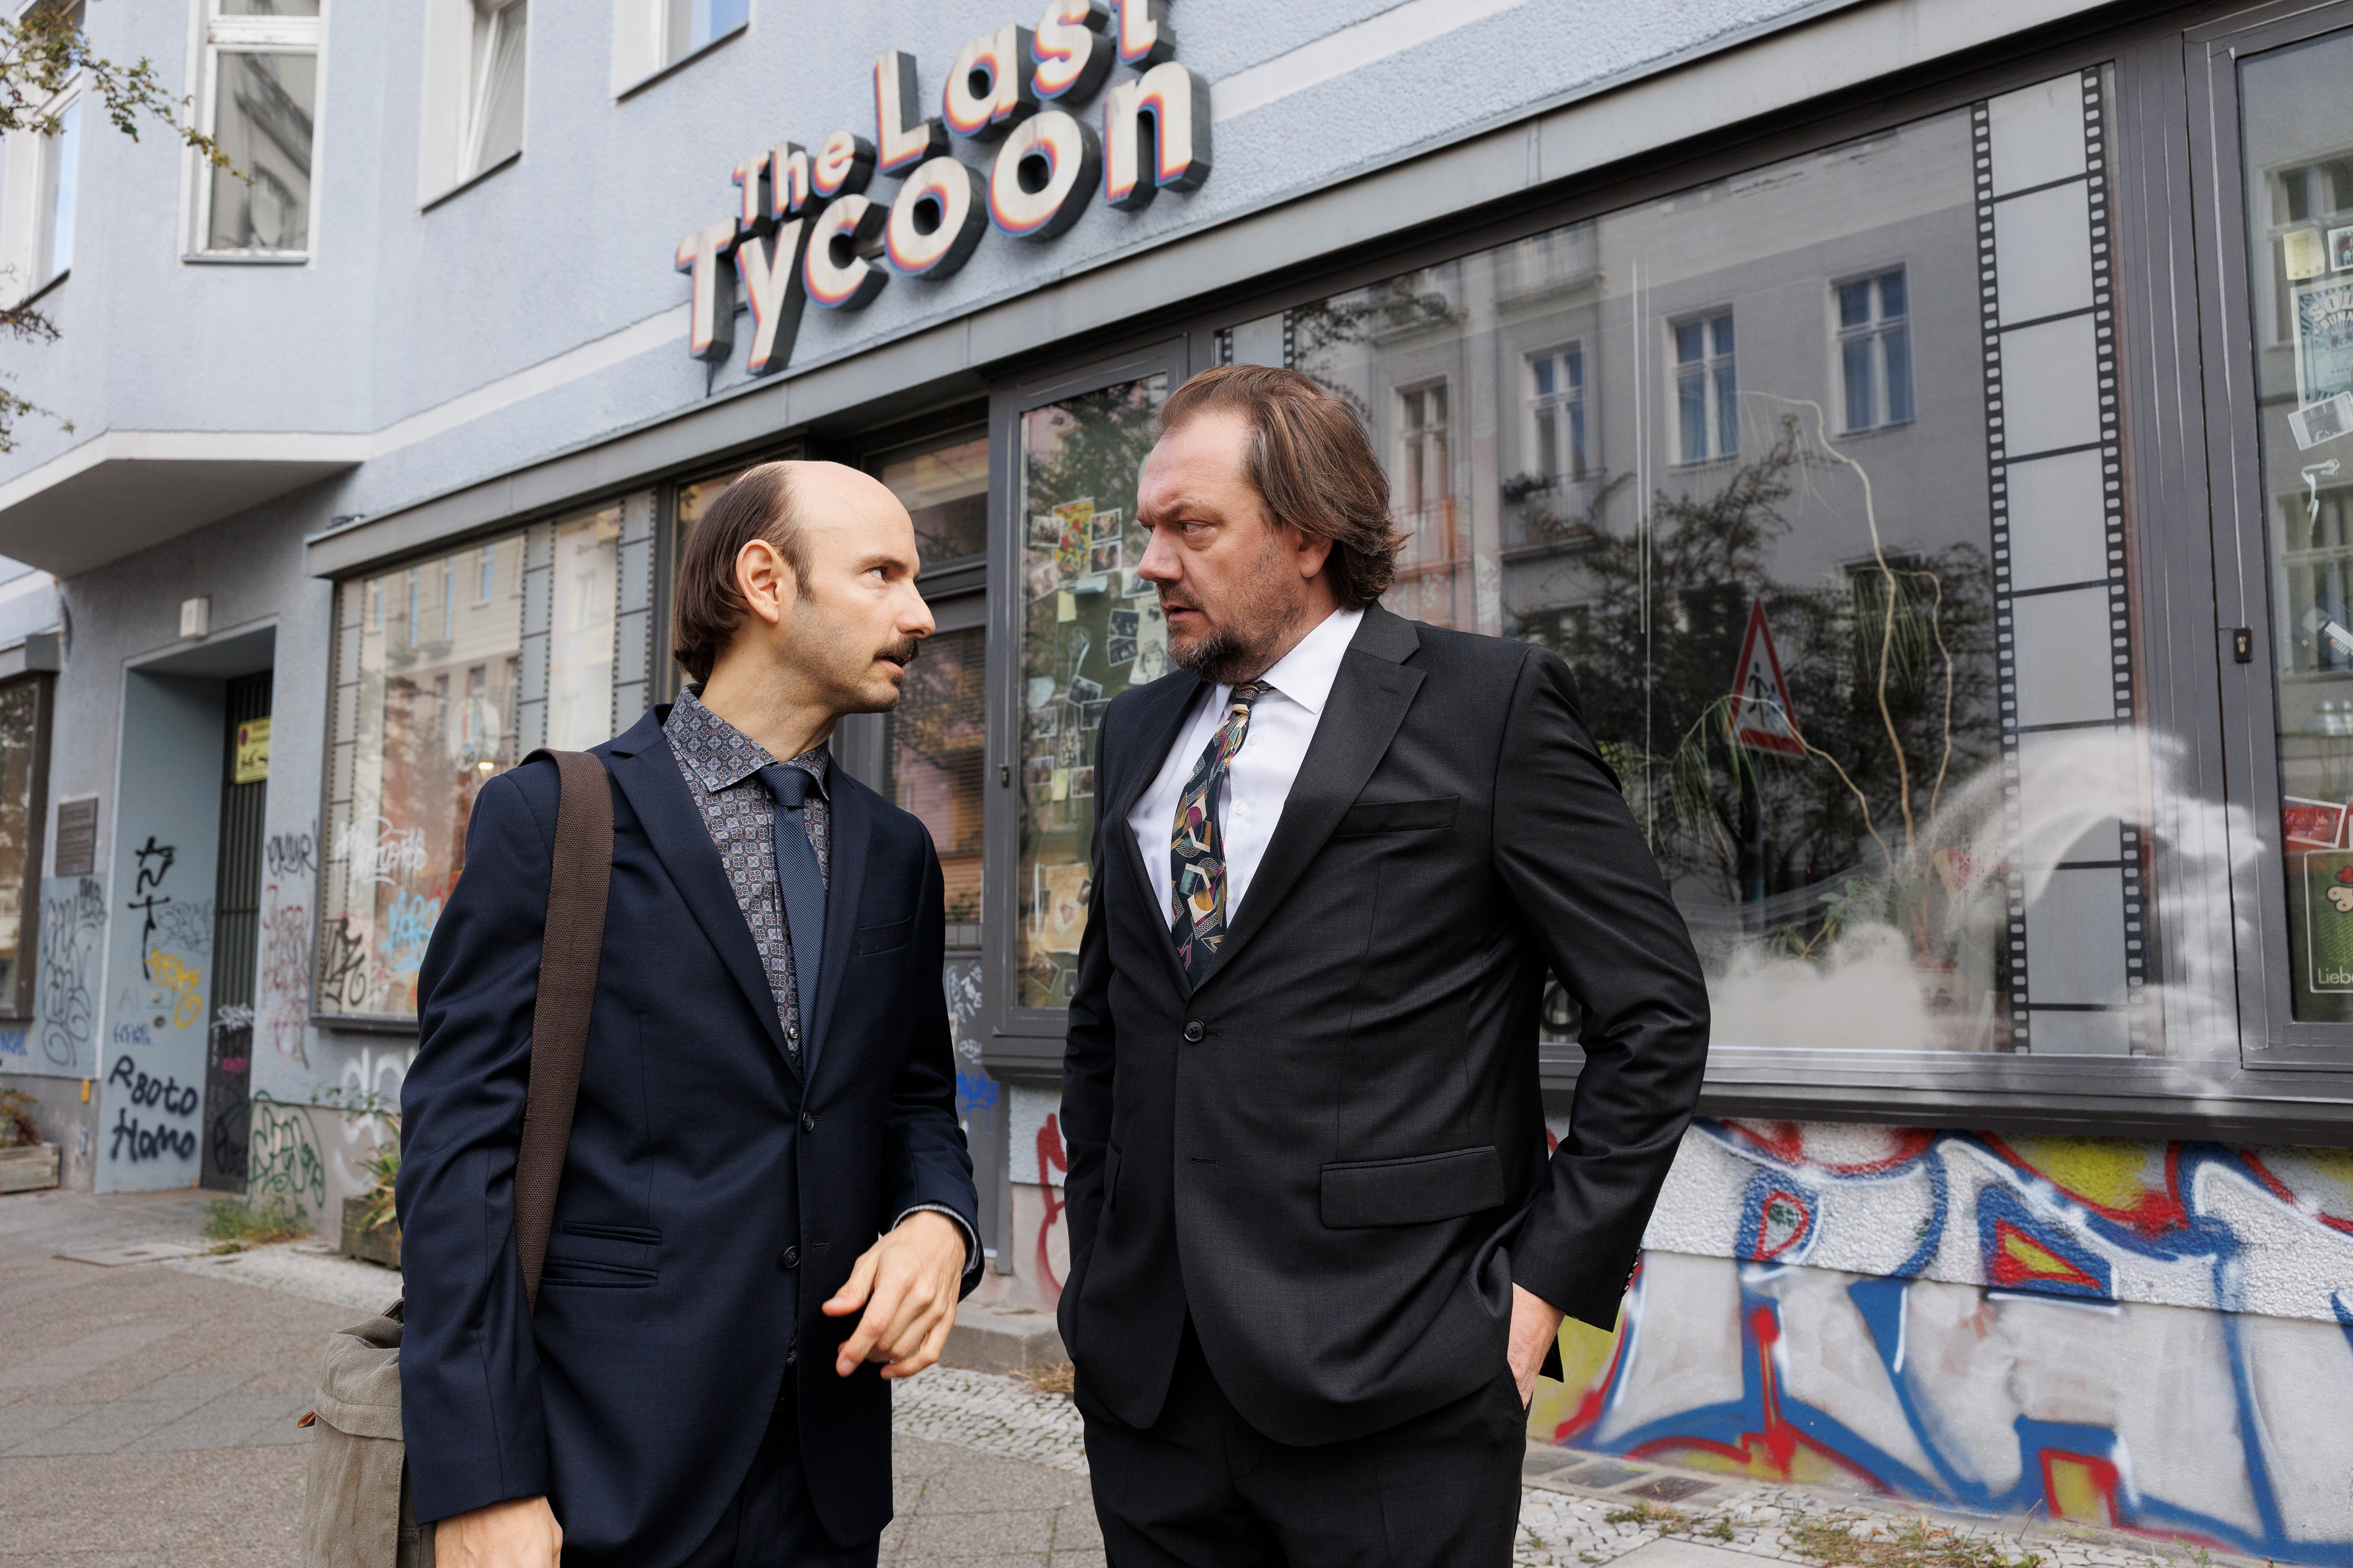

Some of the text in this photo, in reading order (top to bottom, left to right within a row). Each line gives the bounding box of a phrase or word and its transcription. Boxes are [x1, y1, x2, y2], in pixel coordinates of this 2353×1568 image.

[675, 61, 1203, 376] Tycoon
[732, 130, 866, 234] The
[2318, 966, 2353, 985] Lieb
